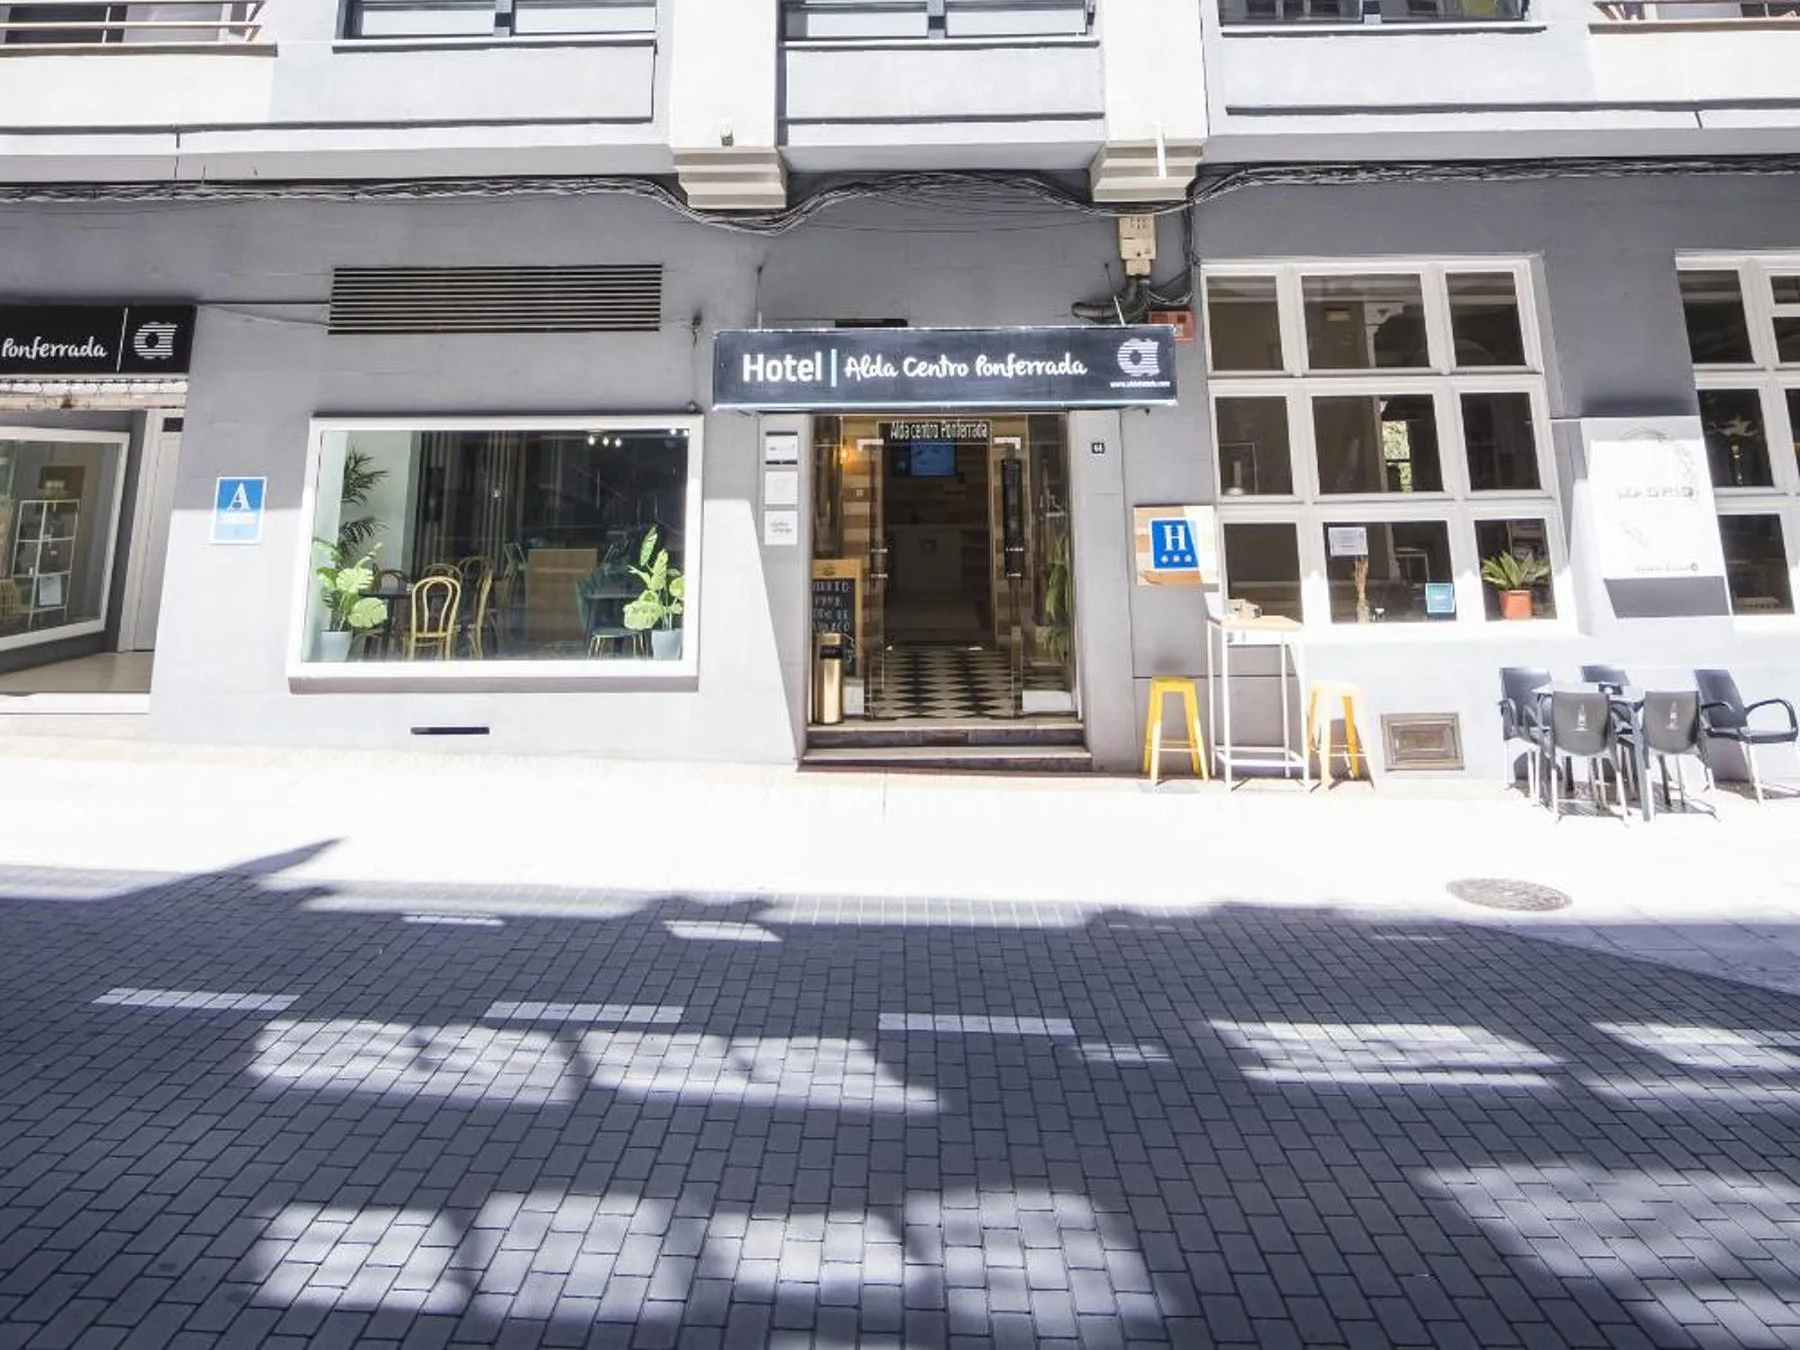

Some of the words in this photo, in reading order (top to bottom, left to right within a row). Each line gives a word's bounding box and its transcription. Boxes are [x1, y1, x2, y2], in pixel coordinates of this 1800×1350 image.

[1, 336, 108, 361] Ponferrada
[742, 351, 823, 383] Hotel
[844, 354, 899, 382] Alda
[902, 353, 969, 378] Centro
[975, 352, 1088, 378] Ponferrada
[225, 481, 253, 511] A
[1163, 524, 1187, 551] H
